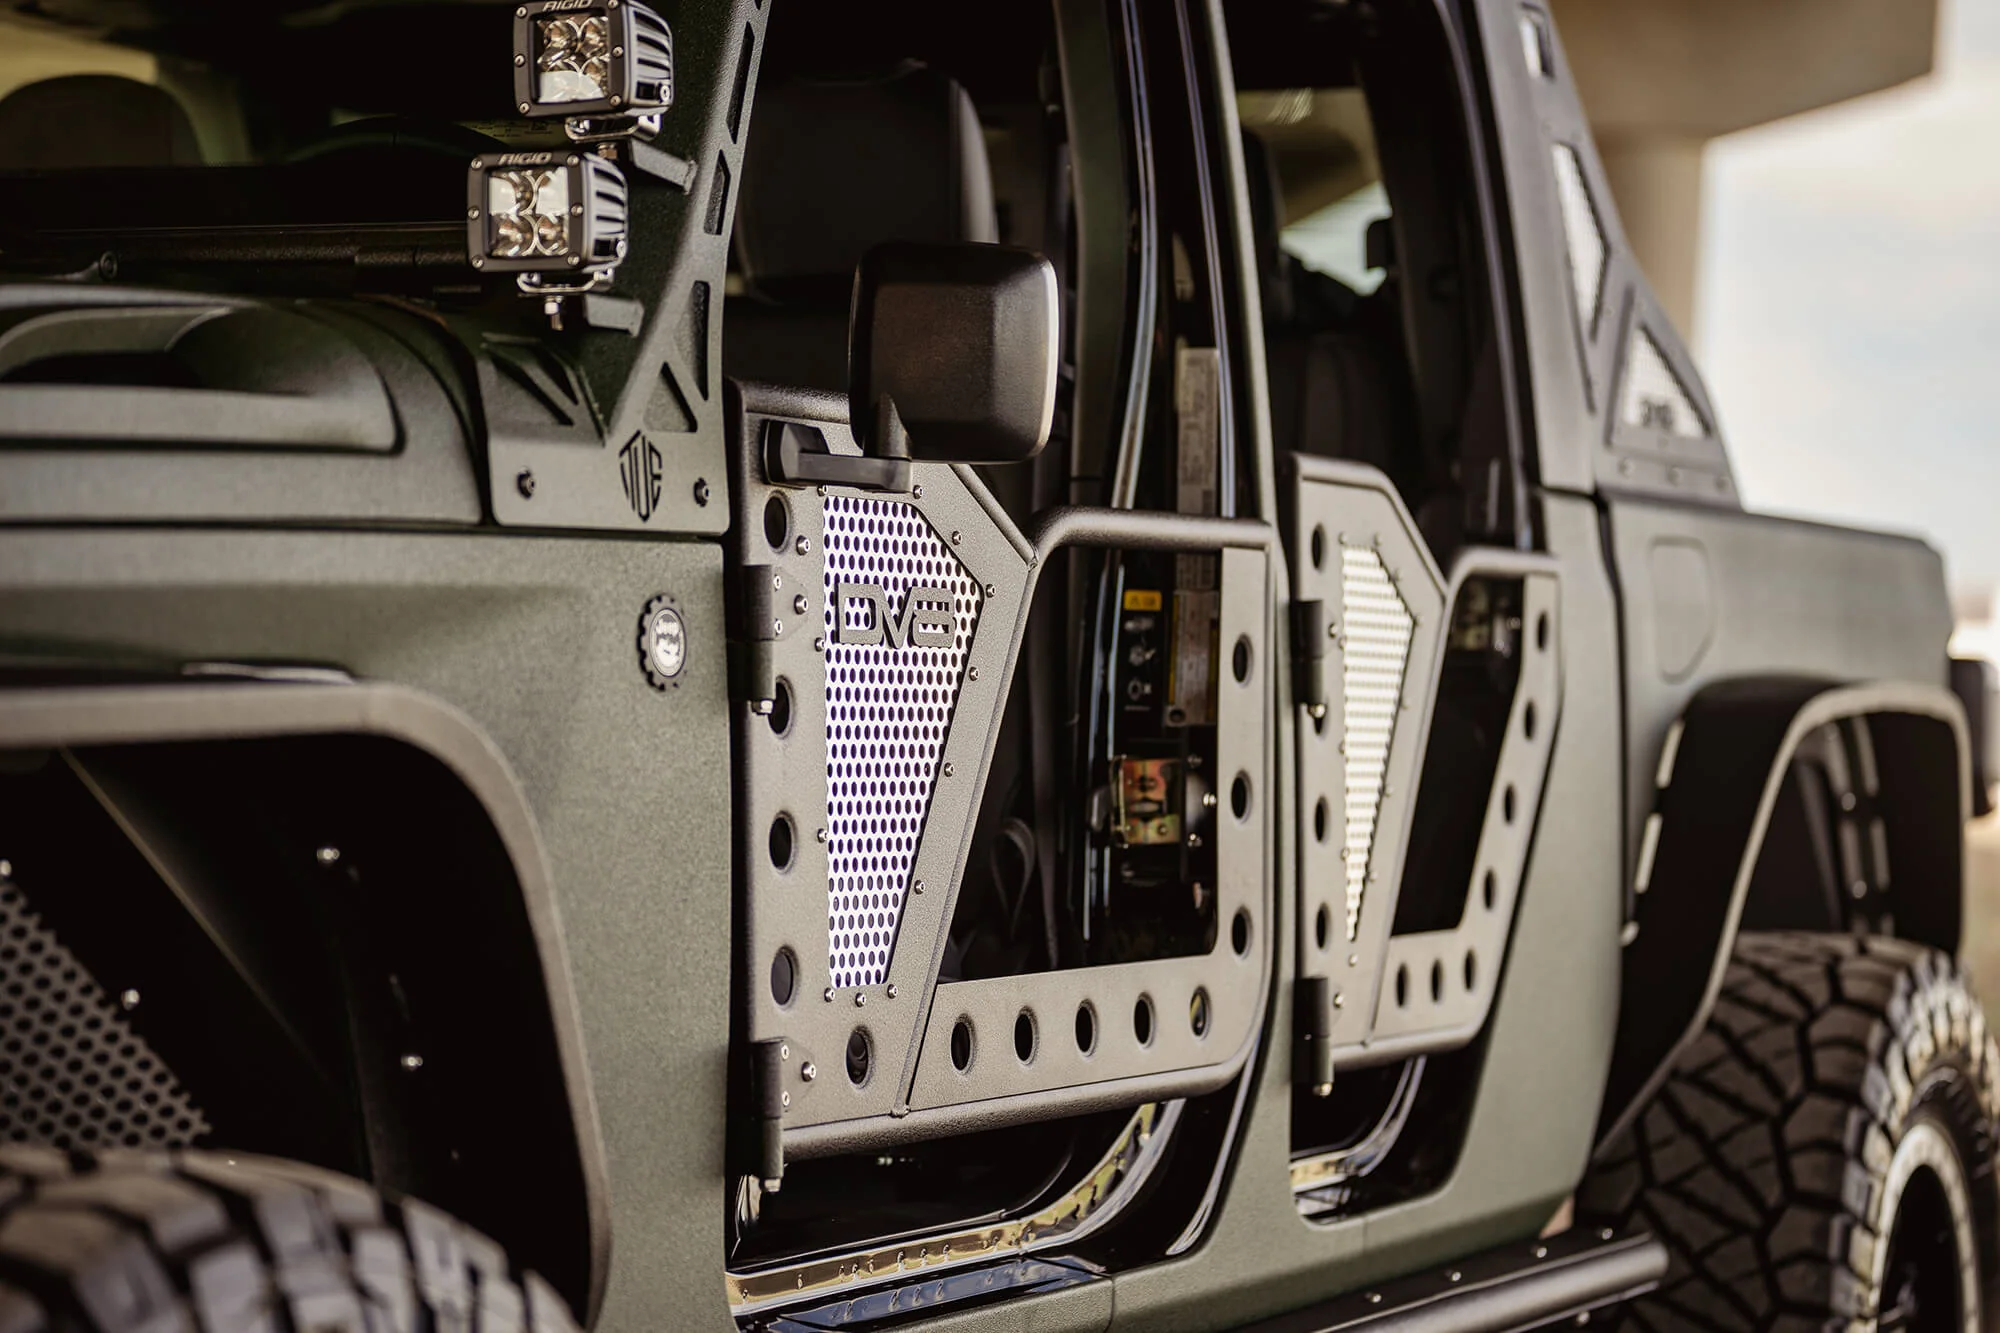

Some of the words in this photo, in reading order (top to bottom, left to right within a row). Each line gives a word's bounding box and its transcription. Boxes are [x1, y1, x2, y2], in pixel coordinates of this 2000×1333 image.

[542, 0, 593, 12] RIGID
[498, 152, 552, 165] RIGID
[837, 582, 956, 650] DV8
